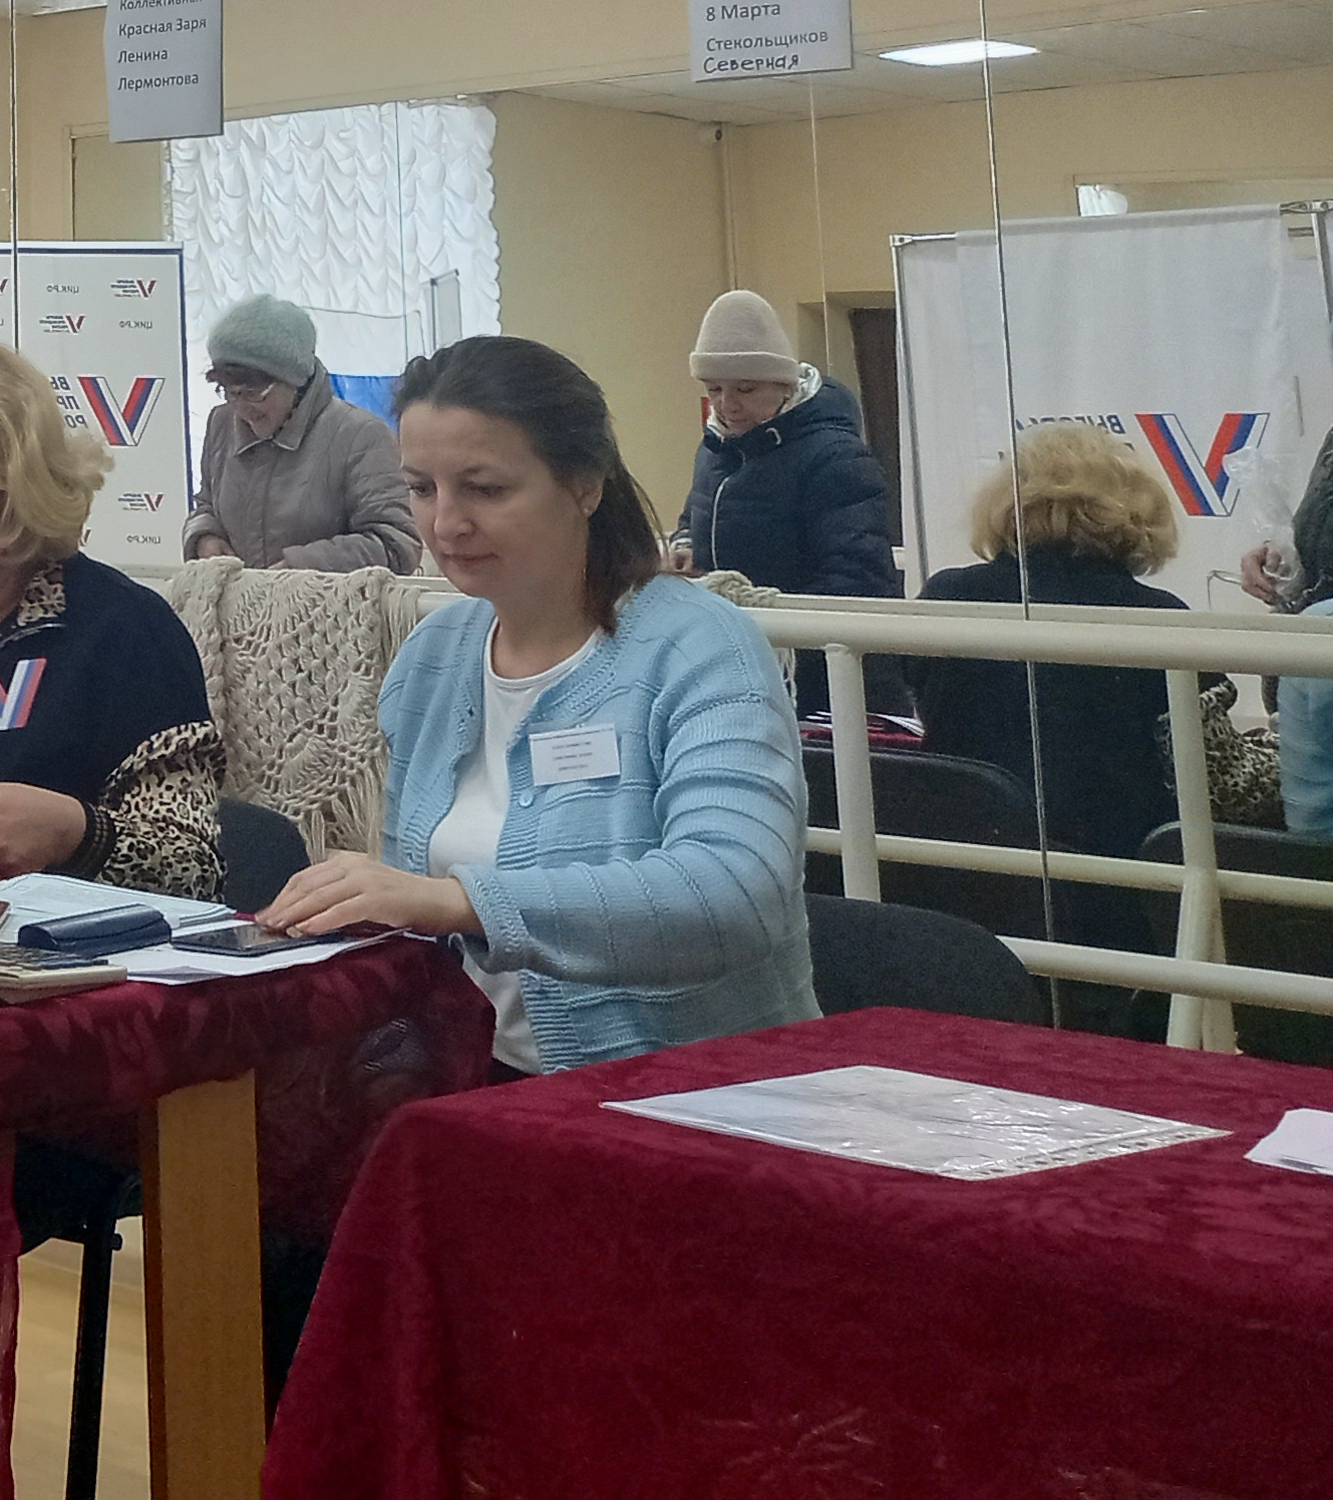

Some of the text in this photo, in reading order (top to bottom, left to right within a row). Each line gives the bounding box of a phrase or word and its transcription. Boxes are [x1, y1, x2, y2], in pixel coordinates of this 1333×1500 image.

[706, 3, 781, 22] 8 Марта
[119, 18, 207, 39] Красная Заря
[706, 31, 829, 51] Стекольщиков
[118, 49, 168, 64] Ленина
[703, 54, 800, 74] Северная
[118, 73, 199, 92] Лермонтова
